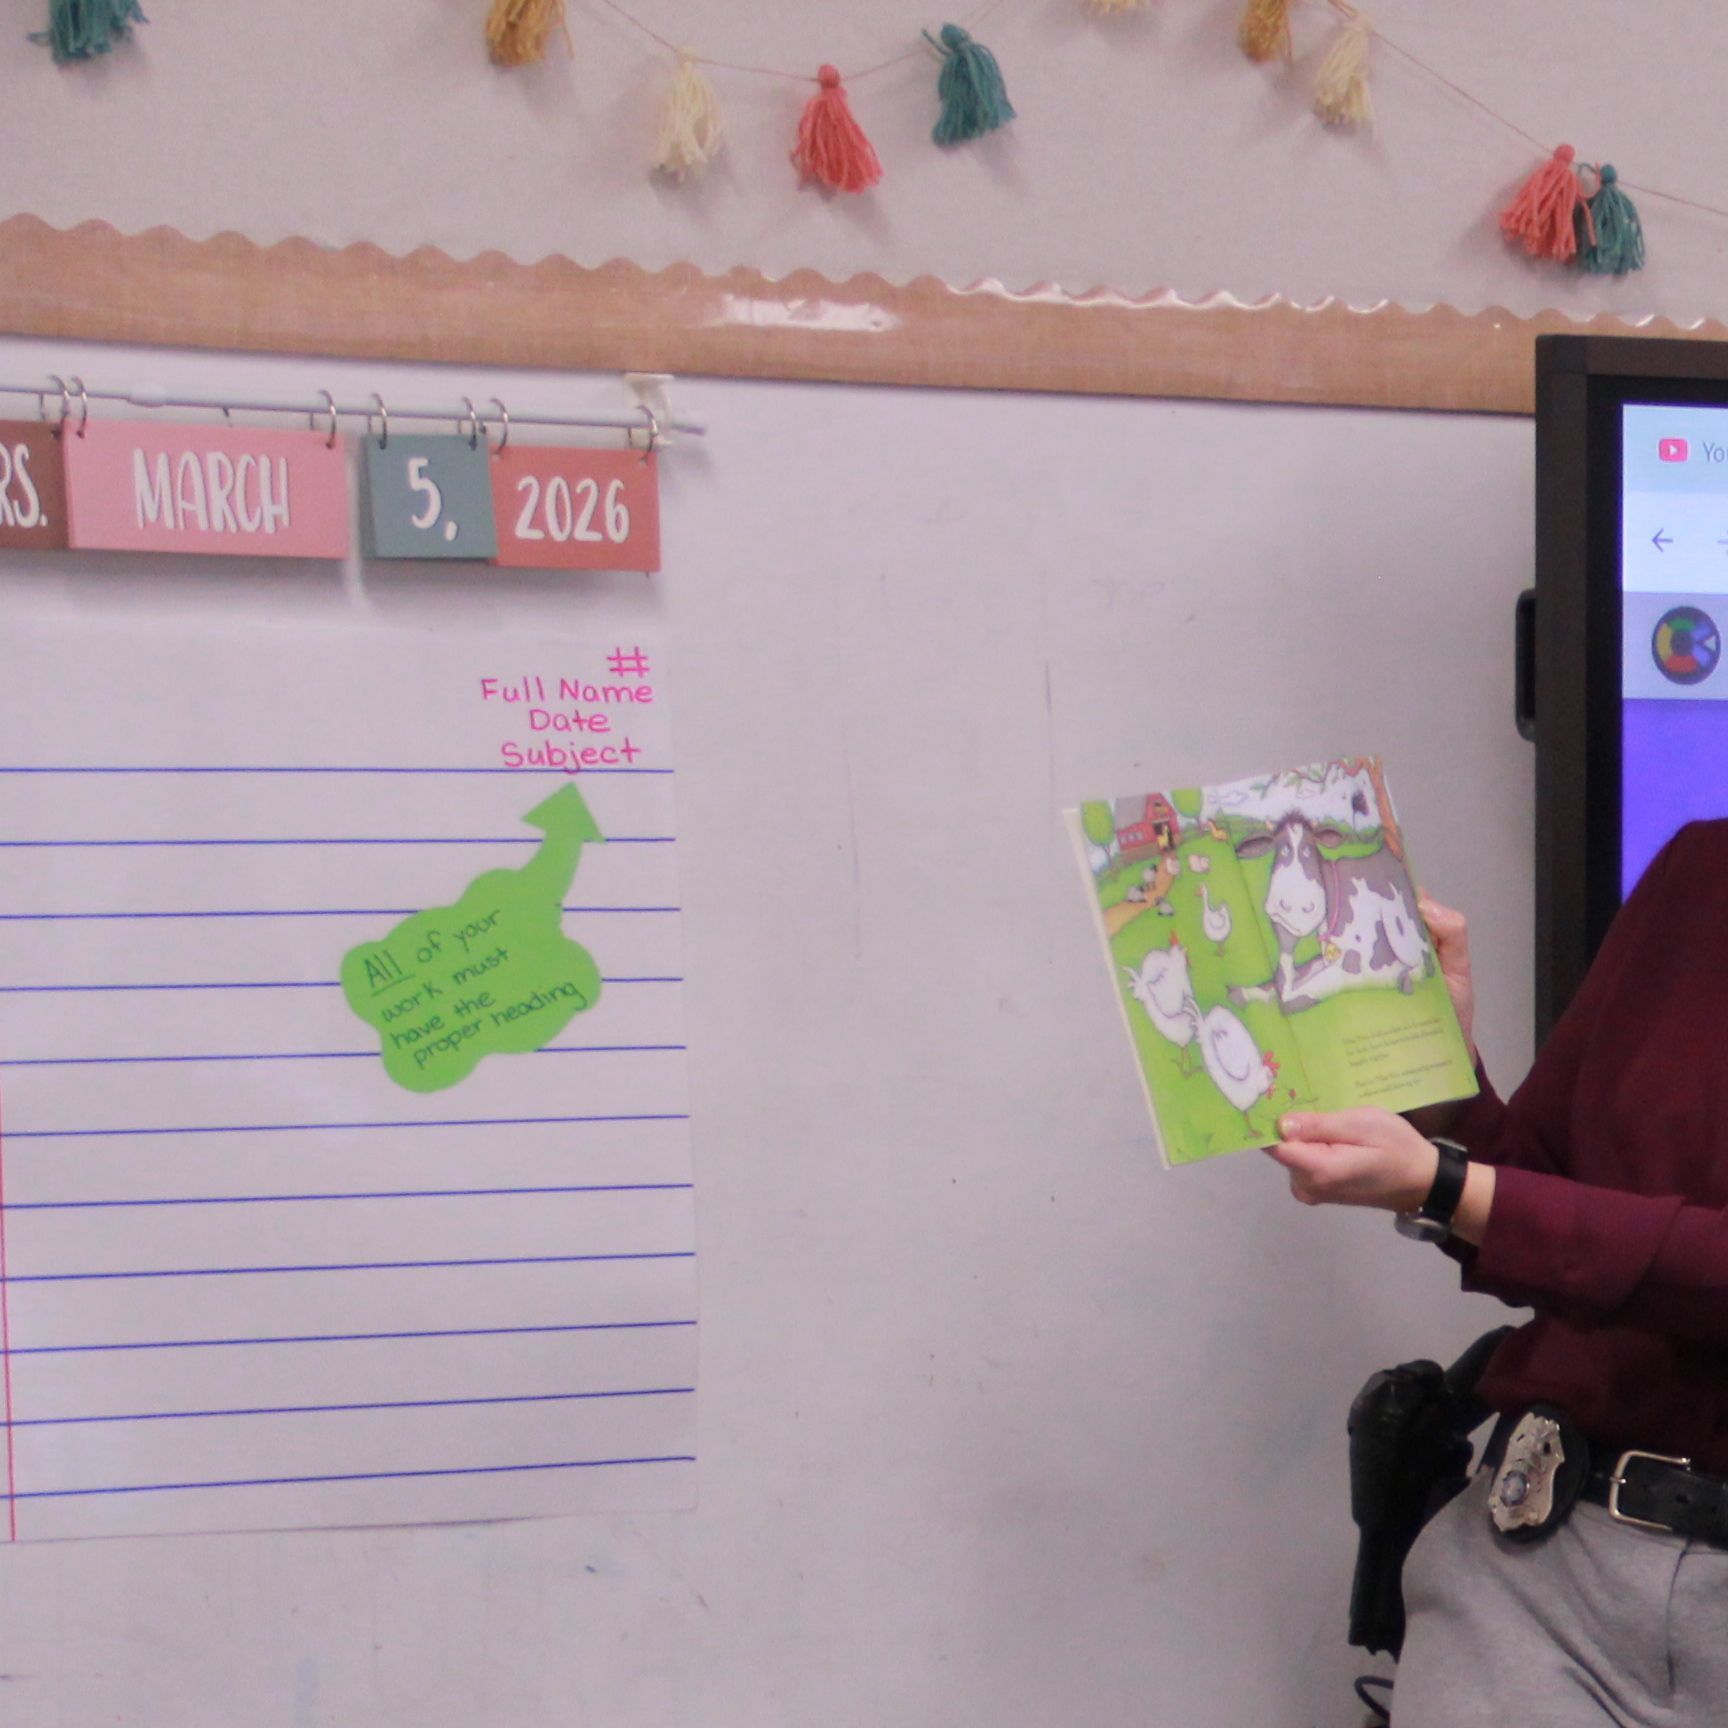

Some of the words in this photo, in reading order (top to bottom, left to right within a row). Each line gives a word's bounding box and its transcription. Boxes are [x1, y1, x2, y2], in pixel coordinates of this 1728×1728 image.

[133, 448, 291, 533] MARCH
[407, 457, 461, 541] 5,
[515, 475, 631, 543] 2026
[480, 677, 547, 704] Full
[559, 679, 654, 704] Name
[607, 647, 650, 677] #
[529, 707, 610, 734] Date
[502, 740, 642, 774] Subject
[363, 950, 403, 989] All
[417, 930, 442, 964] of
[452, 909, 500, 952] your
[381, 981, 443, 1022] work
[452, 947, 510, 986] must
[390, 1014, 445, 1048] have
[454, 990, 497, 1018] the
[413, 1018, 482, 1070] proper
[490, 982, 587, 1028] heading
